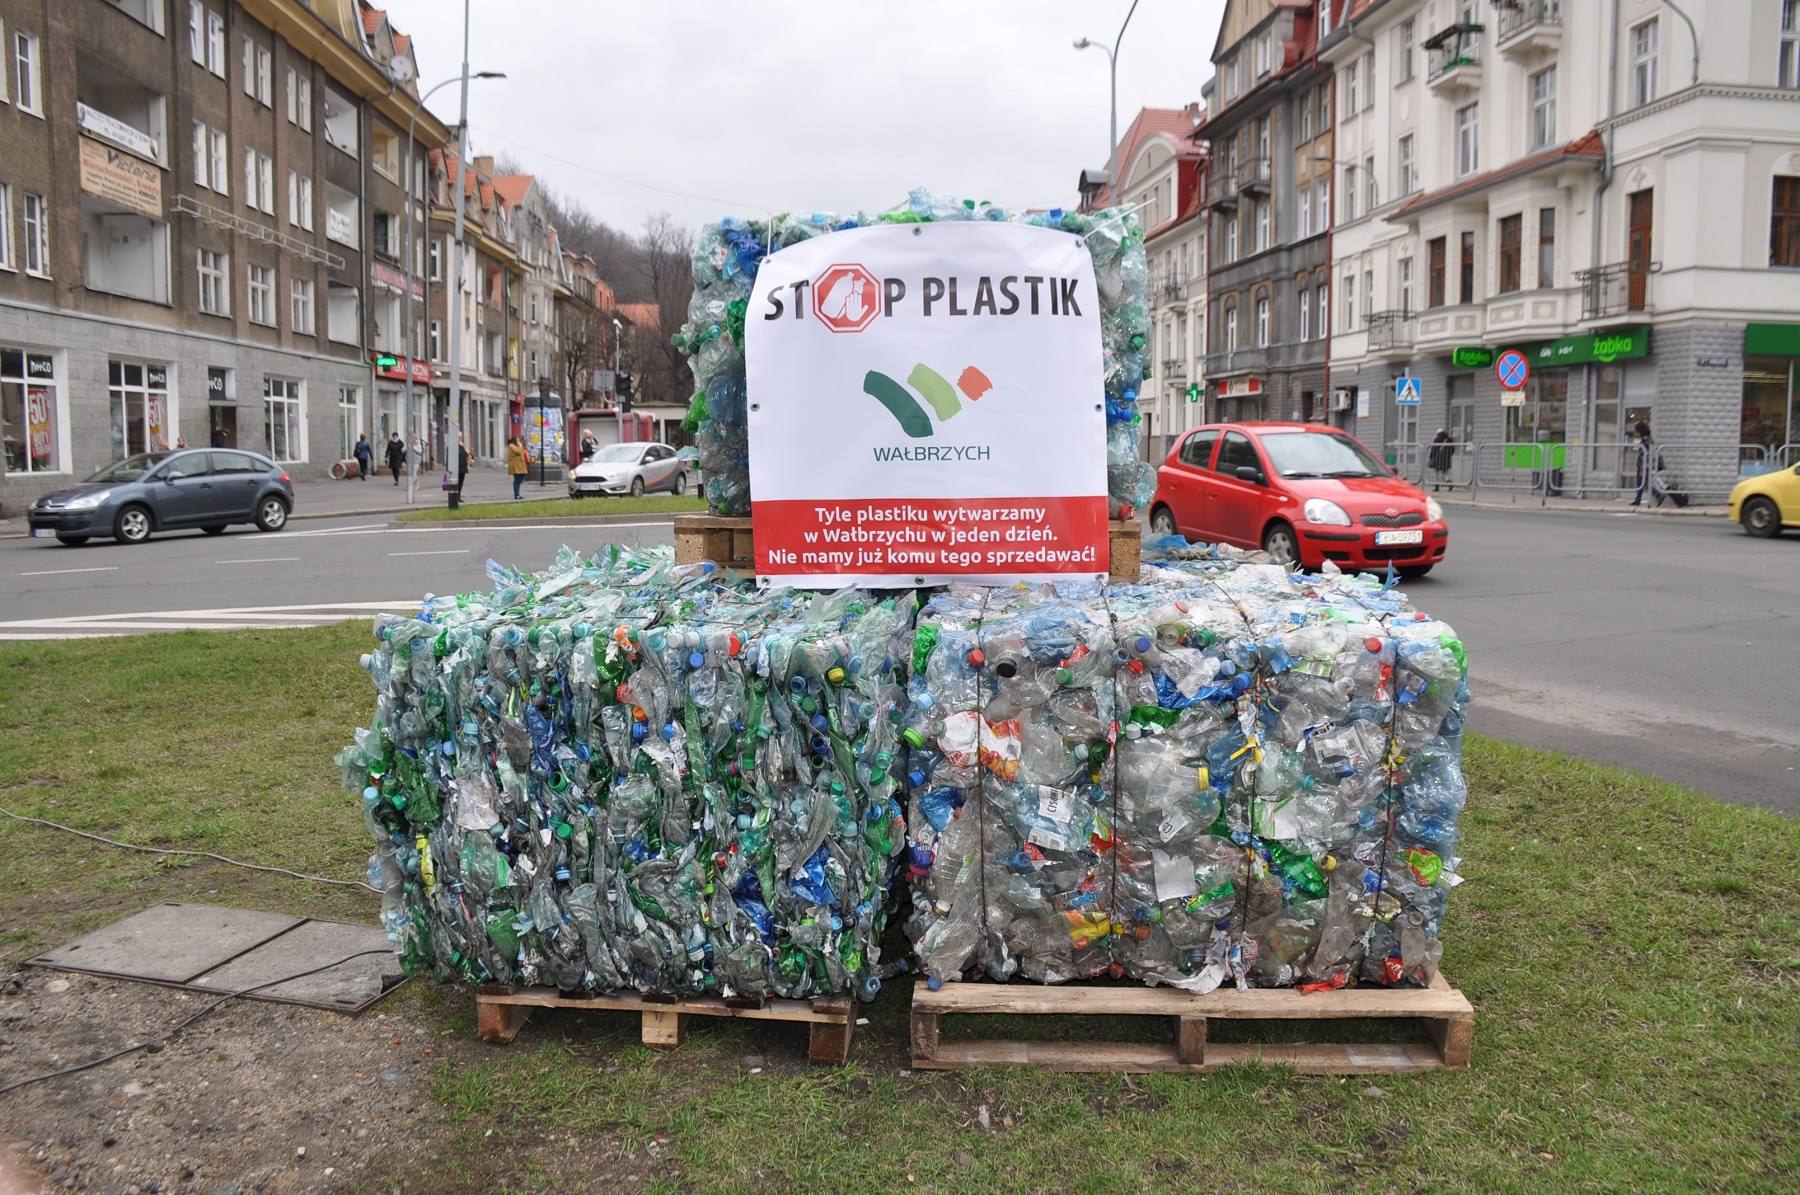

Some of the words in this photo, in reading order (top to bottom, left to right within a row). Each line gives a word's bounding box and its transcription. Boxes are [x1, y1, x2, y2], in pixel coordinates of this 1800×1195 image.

[923, 276, 1082, 316] PLASTIK
[1593, 336, 1632, 355] żabka
[874, 446, 990, 462] WAŁBRZYCH
[815, 506, 852, 525] Tyle
[857, 505, 928, 524] plastiku
[933, 506, 1046, 524] wytwarzamy
[804, 531, 818, 543] w
[823, 527, 926, 546] Wałbrzychu
[931, 530, 946, 543] w
[949, 526, 1000, 545] jeden
[1005, 525, 1058, 542] dzień.
[768, 548, 797, 564] Nie
[802, 550, 853, 566] mamy
[856, 547, 883, 566] już
[888, 548, 935, 564] komu
[941, 549, 981, 566] tego
[987, 545, 1095, 566] sprzedawać!
